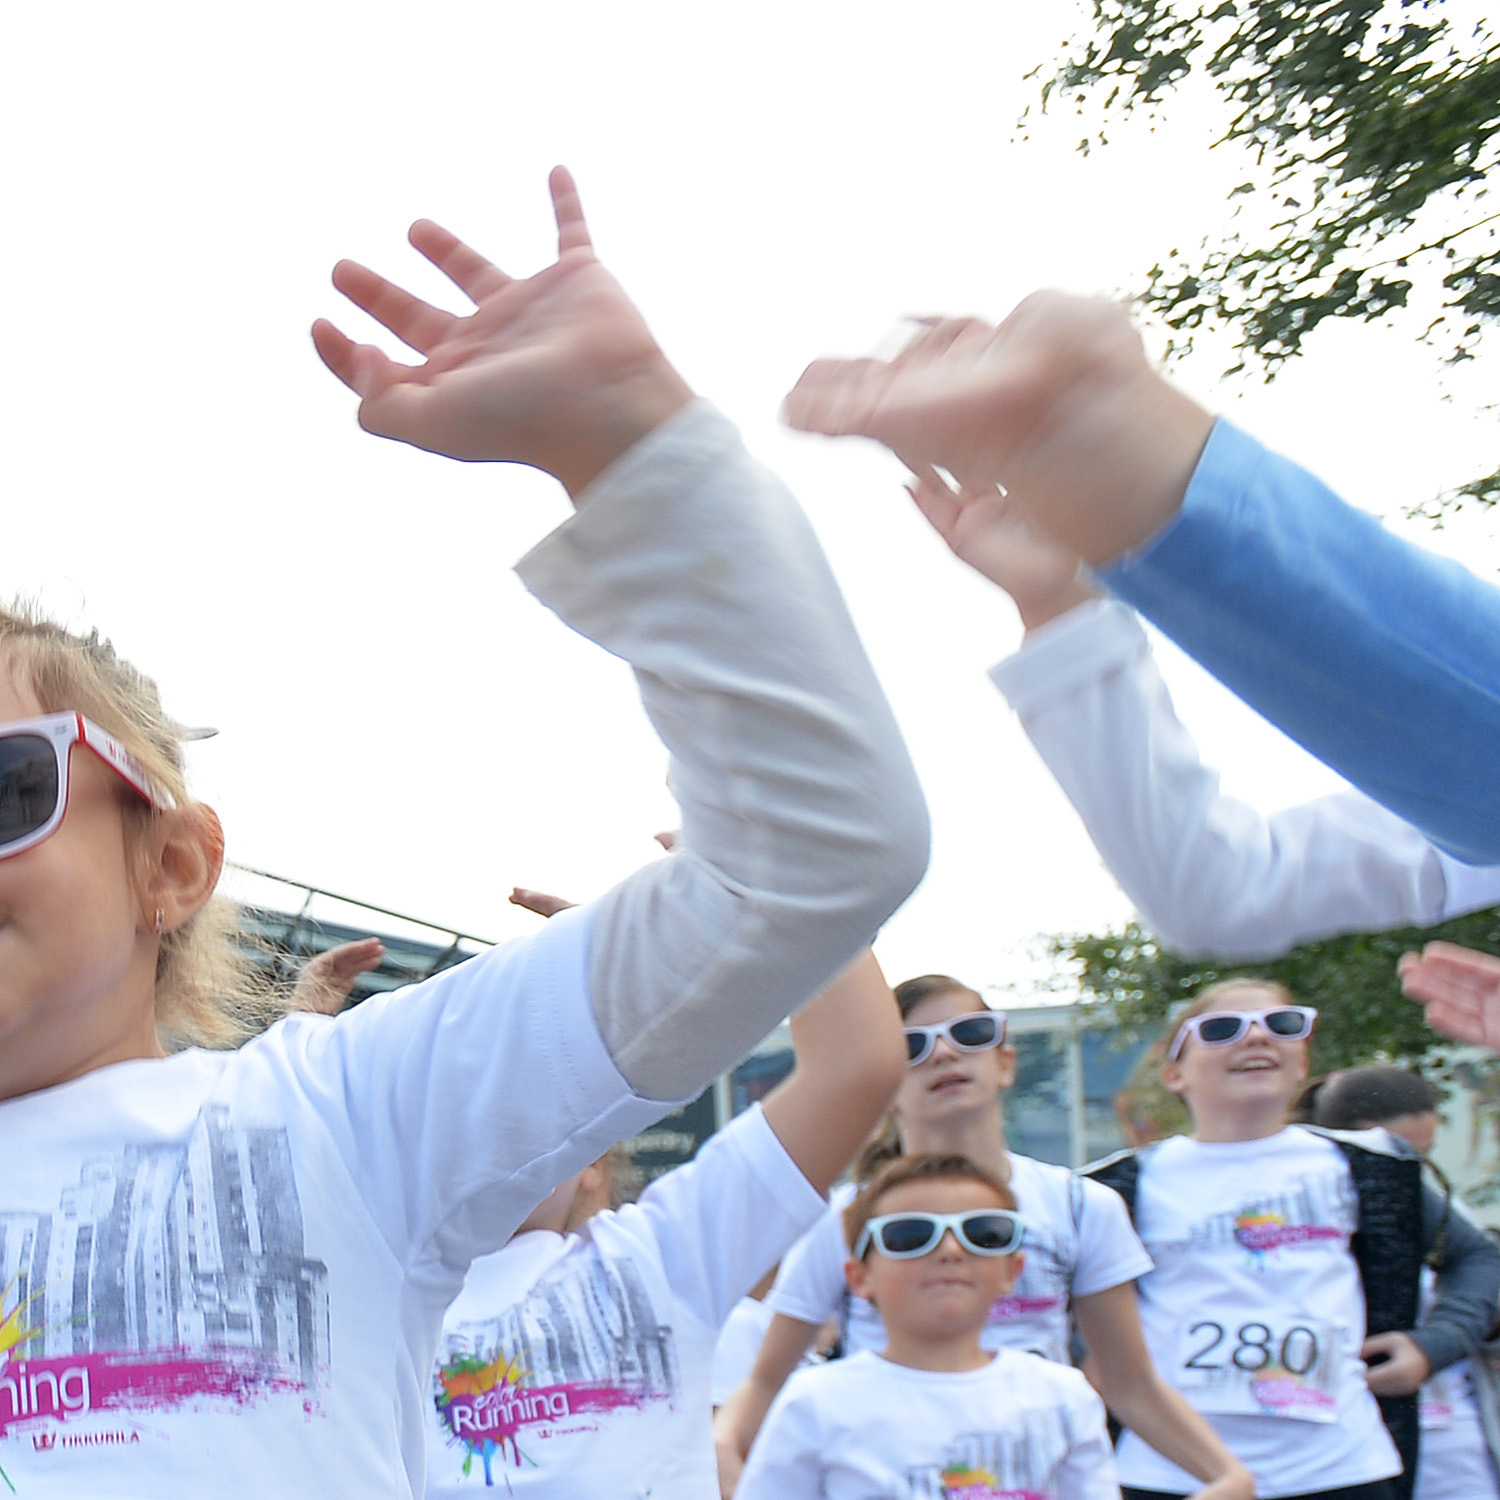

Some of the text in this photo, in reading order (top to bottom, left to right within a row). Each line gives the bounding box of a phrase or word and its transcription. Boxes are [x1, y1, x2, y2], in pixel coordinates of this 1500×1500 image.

[1184, 1321, 1318, 1376] 280
[452, 1390, 570, 1434] Running
[62, 1432, 141, 1448] TIKKURILA
